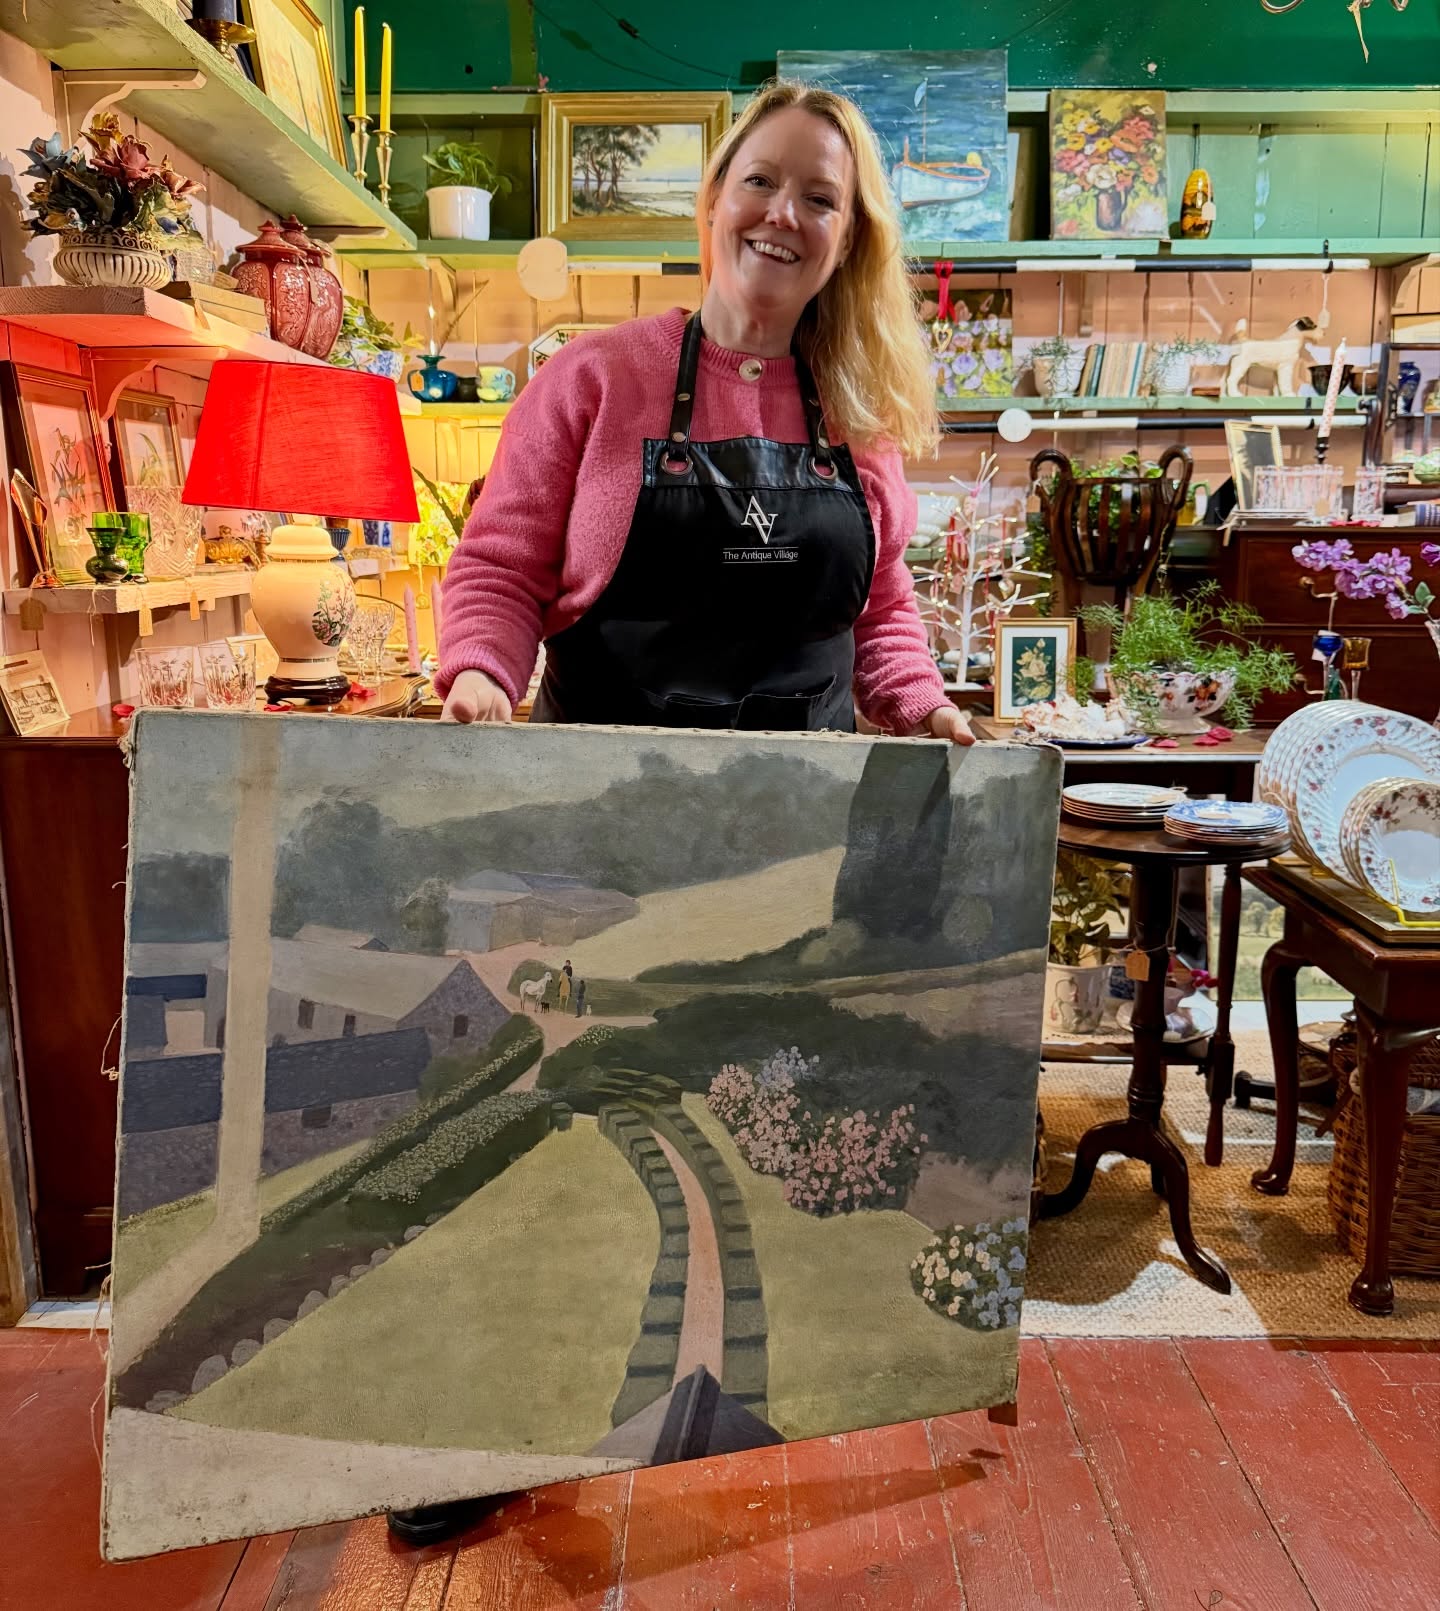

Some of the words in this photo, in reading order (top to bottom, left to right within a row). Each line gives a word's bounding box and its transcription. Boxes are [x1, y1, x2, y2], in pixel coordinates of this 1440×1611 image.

[722, 551, 739, 560] The
[740, 550, 771, 562] Antique
[773, 549, 798, 561] Village
